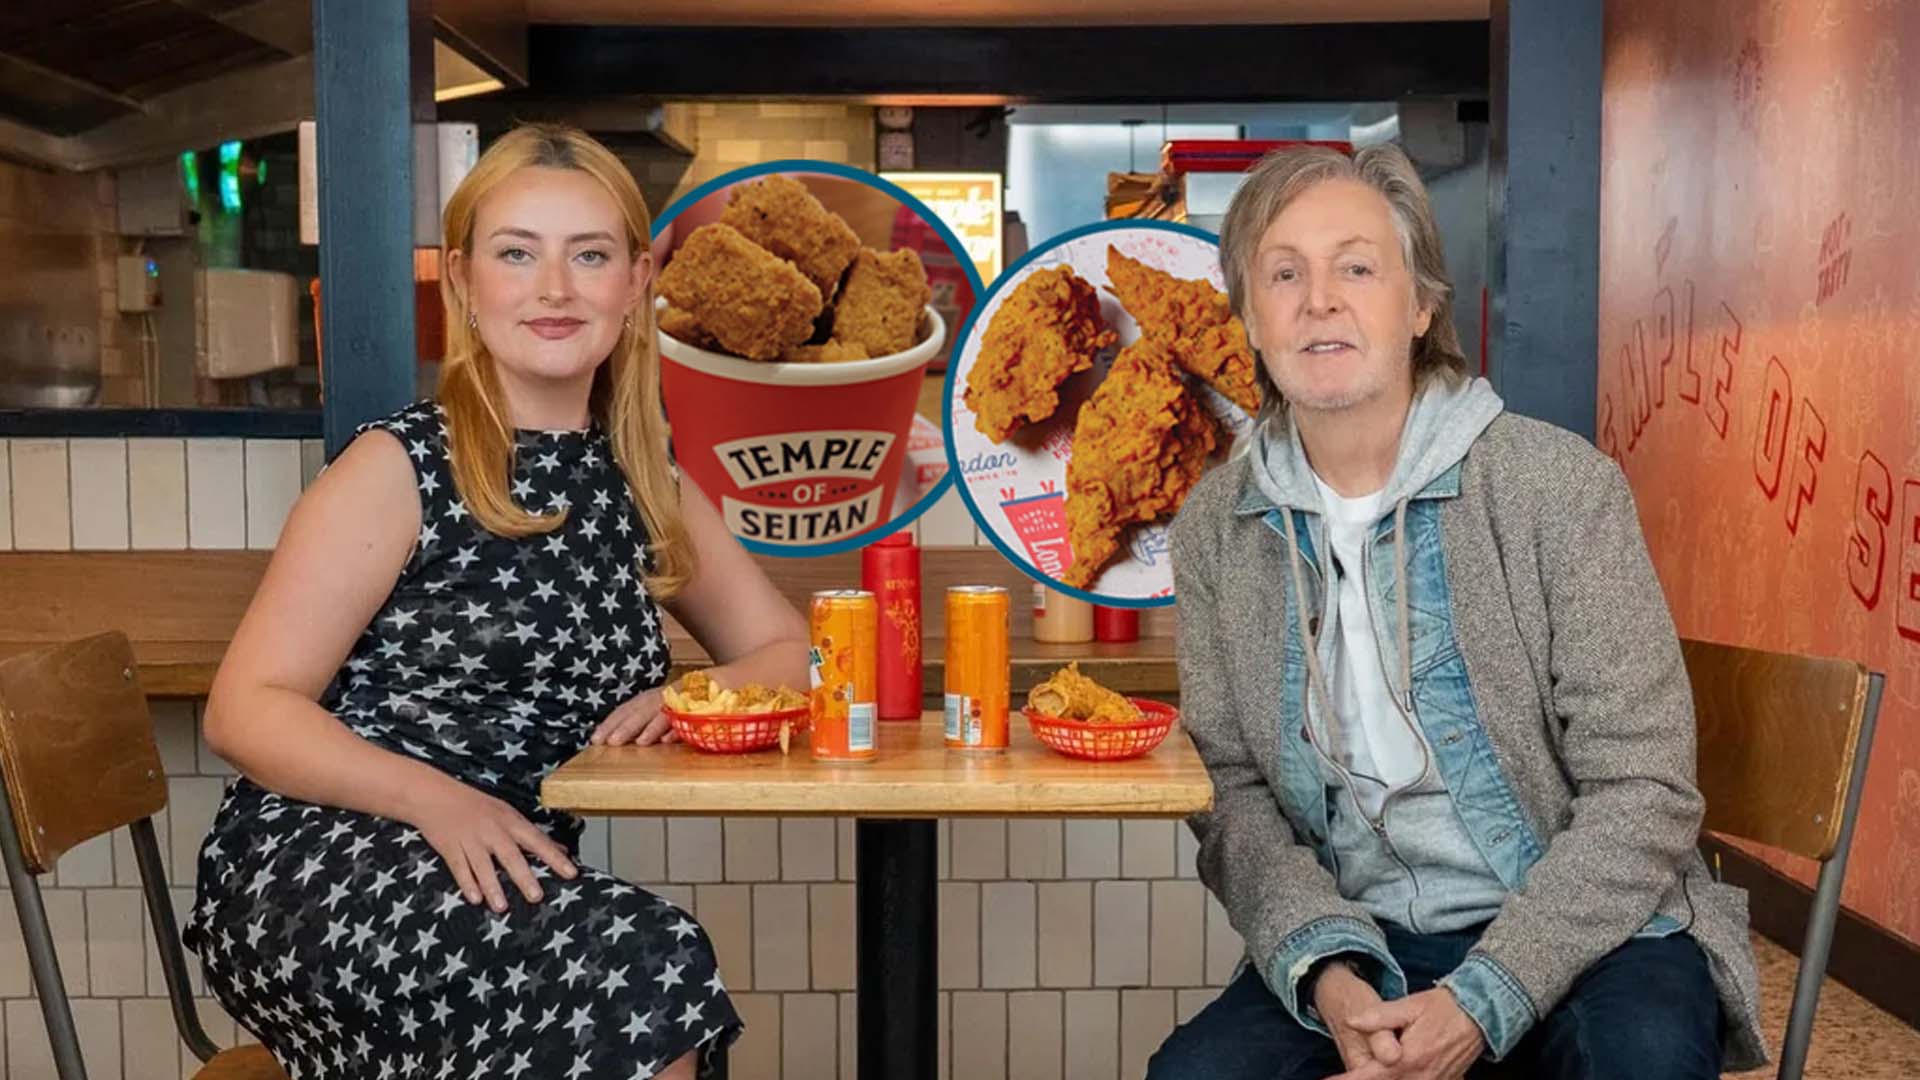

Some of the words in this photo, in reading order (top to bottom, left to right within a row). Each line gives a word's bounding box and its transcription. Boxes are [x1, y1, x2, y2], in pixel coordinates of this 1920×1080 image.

[728, 438, 886, 481] TEMPLE
[1753, 354, 1827, 537] OF
[792, 483, 827, 504] OF
[740, 499, 869, 541] SEITAN
